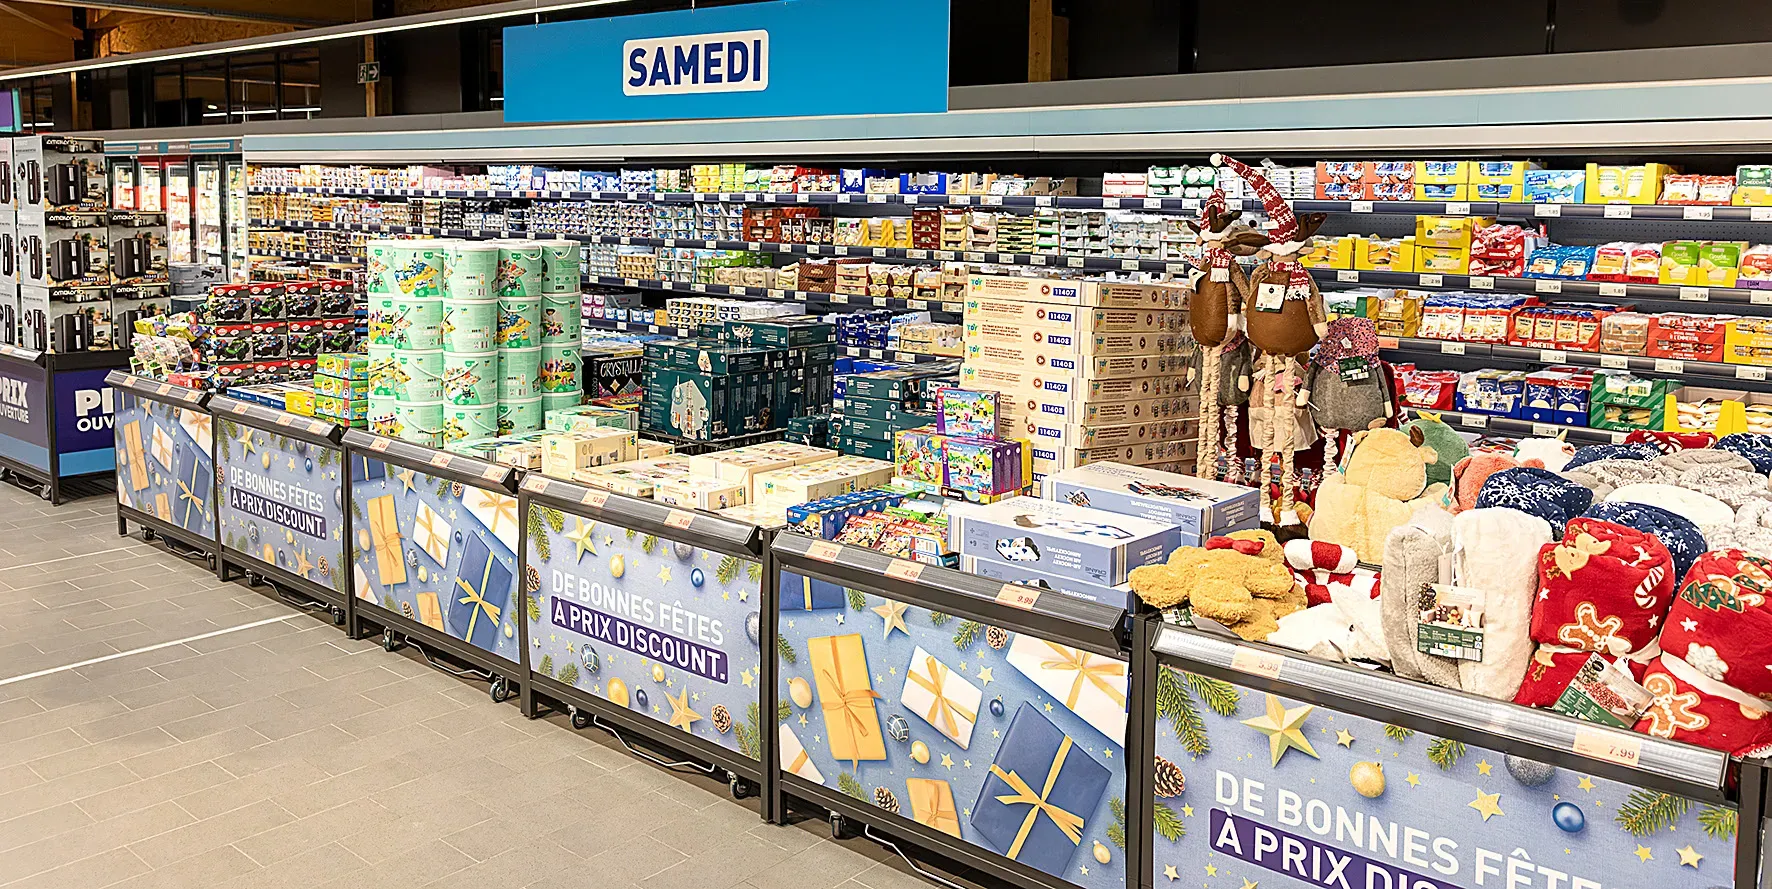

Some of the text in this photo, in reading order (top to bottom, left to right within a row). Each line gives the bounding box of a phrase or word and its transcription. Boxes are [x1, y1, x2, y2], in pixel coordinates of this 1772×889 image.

[628, 39, 761, 88] SAMEDI
[1055, 288, 1075, 297] 11407
[1050, 313, 1070, 321] 11407
[1049, 336, 1070, 345] 11408
[1053, 360, 1073, 369] 11408
[1046, 383, 1066, 391] 11407
[1043, 405, 1063, 414] 11408
[1040, 428, 1060, 437] 11407
[1034, 450, 1054, 459] 11408
[230, 466, 324, 513] DE BONNES FÊTES
[232, 485, 326, 538] À PRIX DISCOUNT.
[903, 569, 919, 579] 4.50
[1084, 566, 1107, 575] CRANE
[1016, 595, 1035, 605] 9.99
[552, 568, 724, 646] DE BONNES FÊTES
[553, 595, 727, 681] À PRIX DISCOUNT.
[1258, 660, 1280, 672] 5.99
[1608, 744, 1636, 760] 7.99
[1215, 769, 1266, 817] DE
[1277, 787, 1461, 876] BONNES
[1215, 806, 1244, 855] À
[1253, 826, 1355, 889] PRIX
